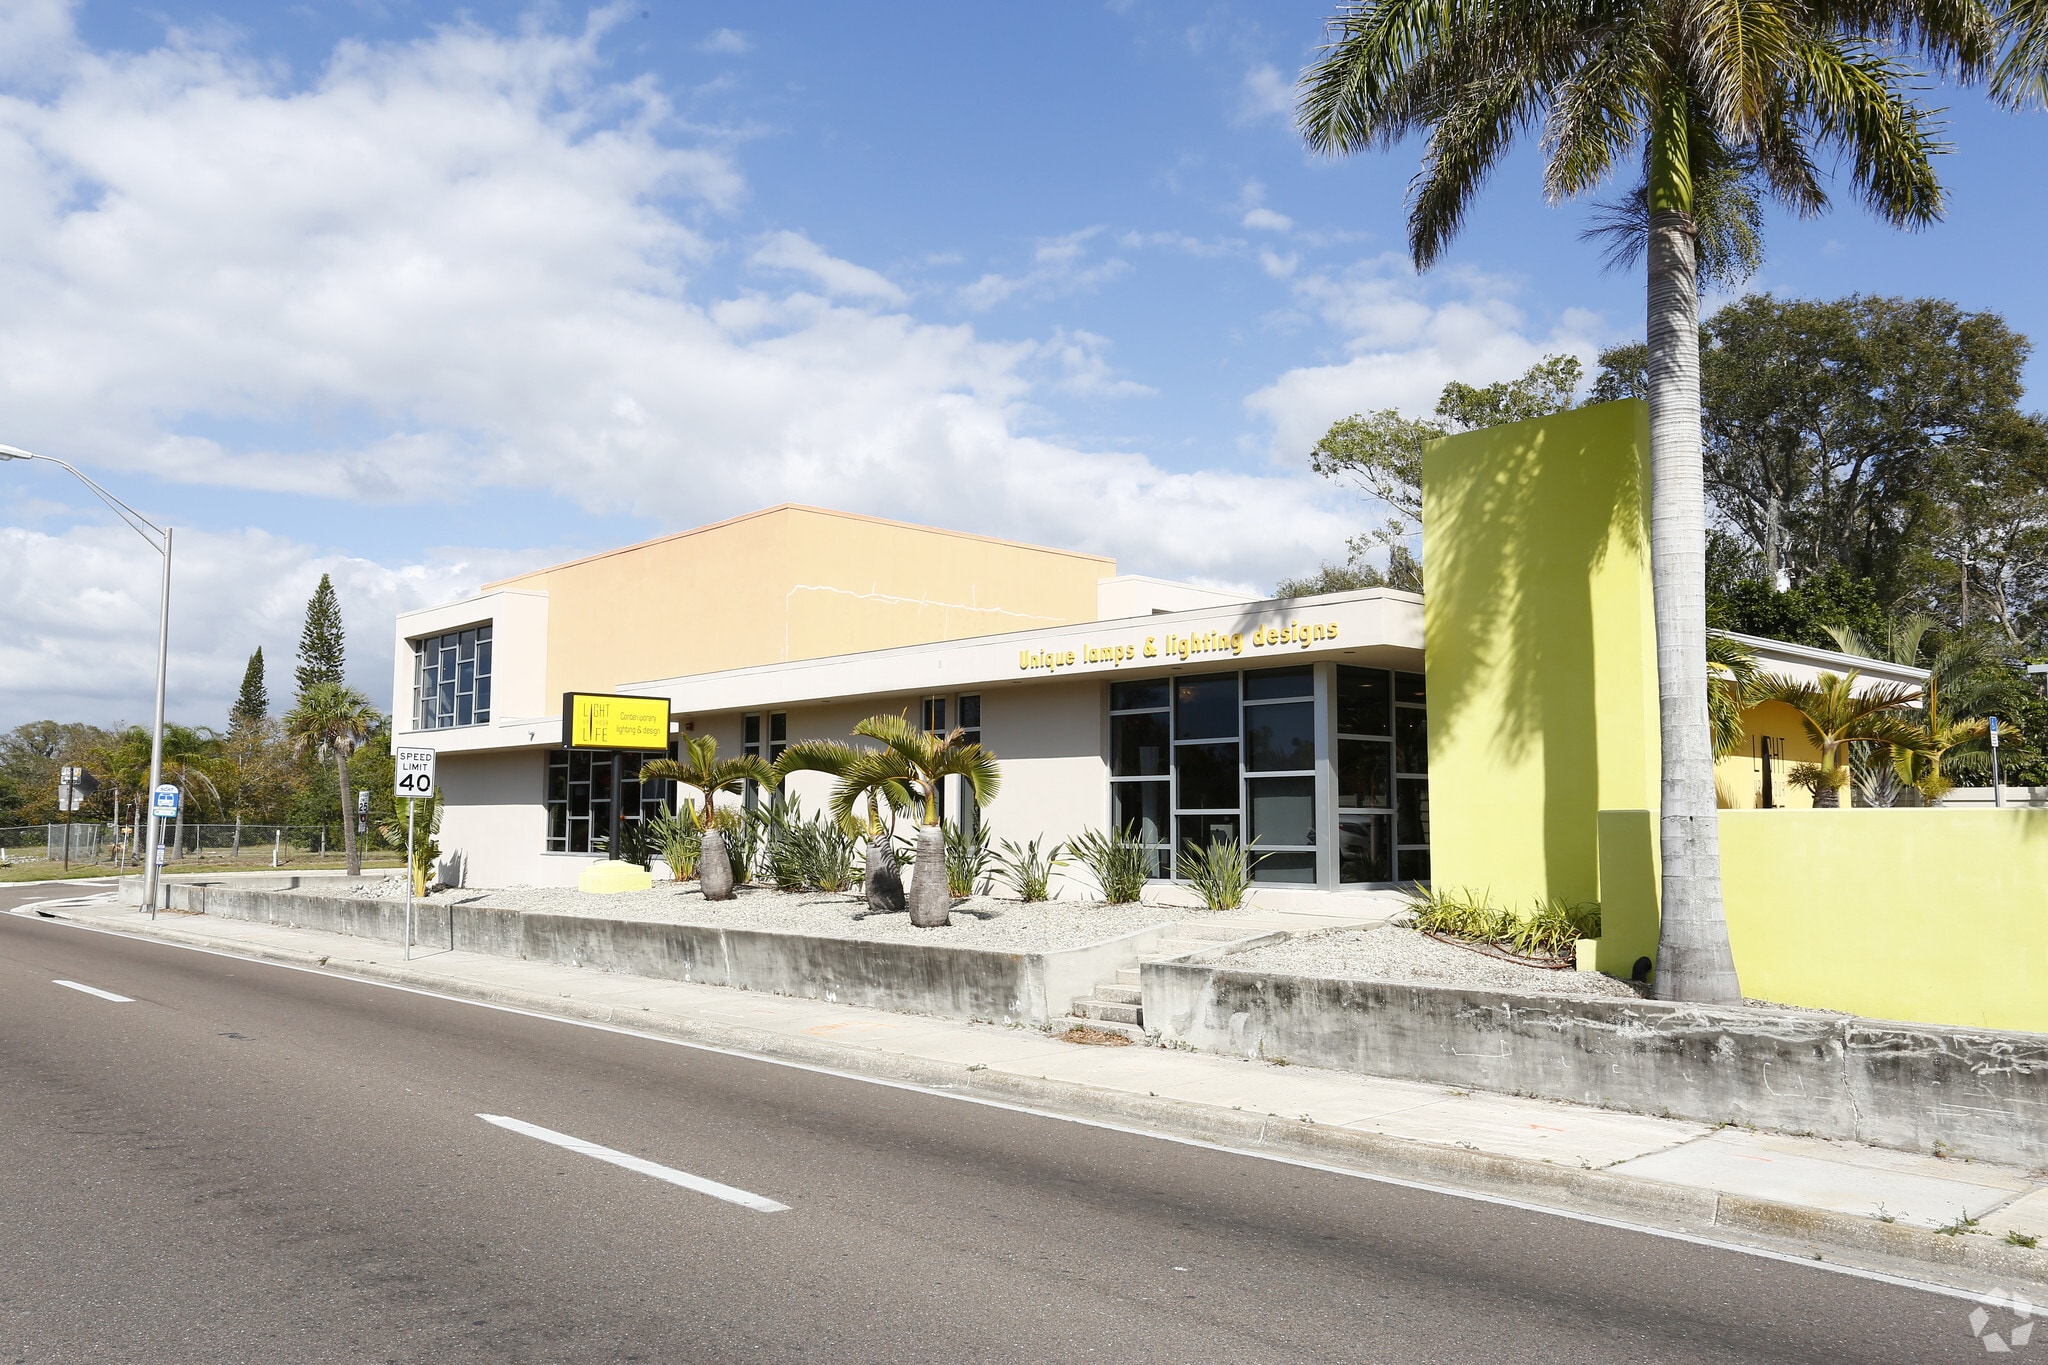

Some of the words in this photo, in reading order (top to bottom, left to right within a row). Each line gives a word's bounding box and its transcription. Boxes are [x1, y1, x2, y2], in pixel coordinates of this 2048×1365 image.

[1019, 649, 1075, 673] Unique
[1083, 643, 1135, 667] lamps
[1143, 636, 1157, 658] &
[1166, 630, 1244, 661] lighting
[1253, 620, 1338, 649] designs
[583, 703, 610, 718] LIGHT
[582, 728, 608, 742] LIFE
[637, 725, 642, 734] &
[643, 726, 661, 737] design
[400, 752, 432, 761] SPEED
[403, 763, 428, 771] LIMIT
[399, 773, 431, 792] 40
[359, 803, 368, 811] 25
